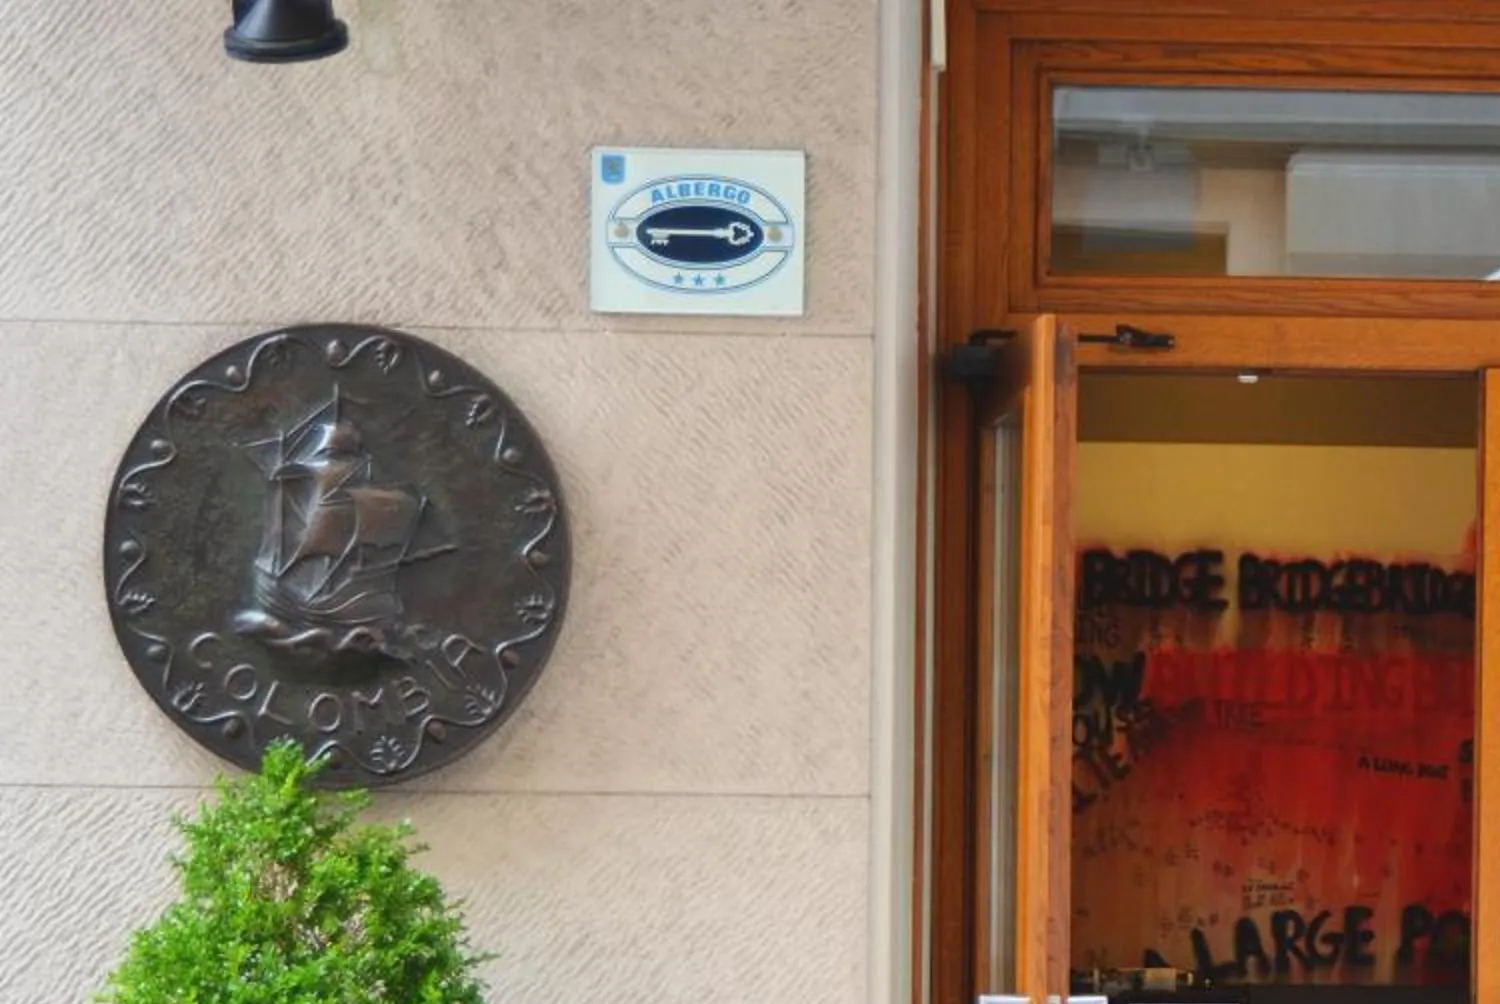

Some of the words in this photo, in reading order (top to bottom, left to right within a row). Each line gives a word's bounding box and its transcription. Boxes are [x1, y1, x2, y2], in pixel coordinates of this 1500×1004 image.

[651, 181, 751, 204] ALBERGO
[188, 631, 484, 736] COLOMBIA
[1190, 906, 1377, 978] LARGE
